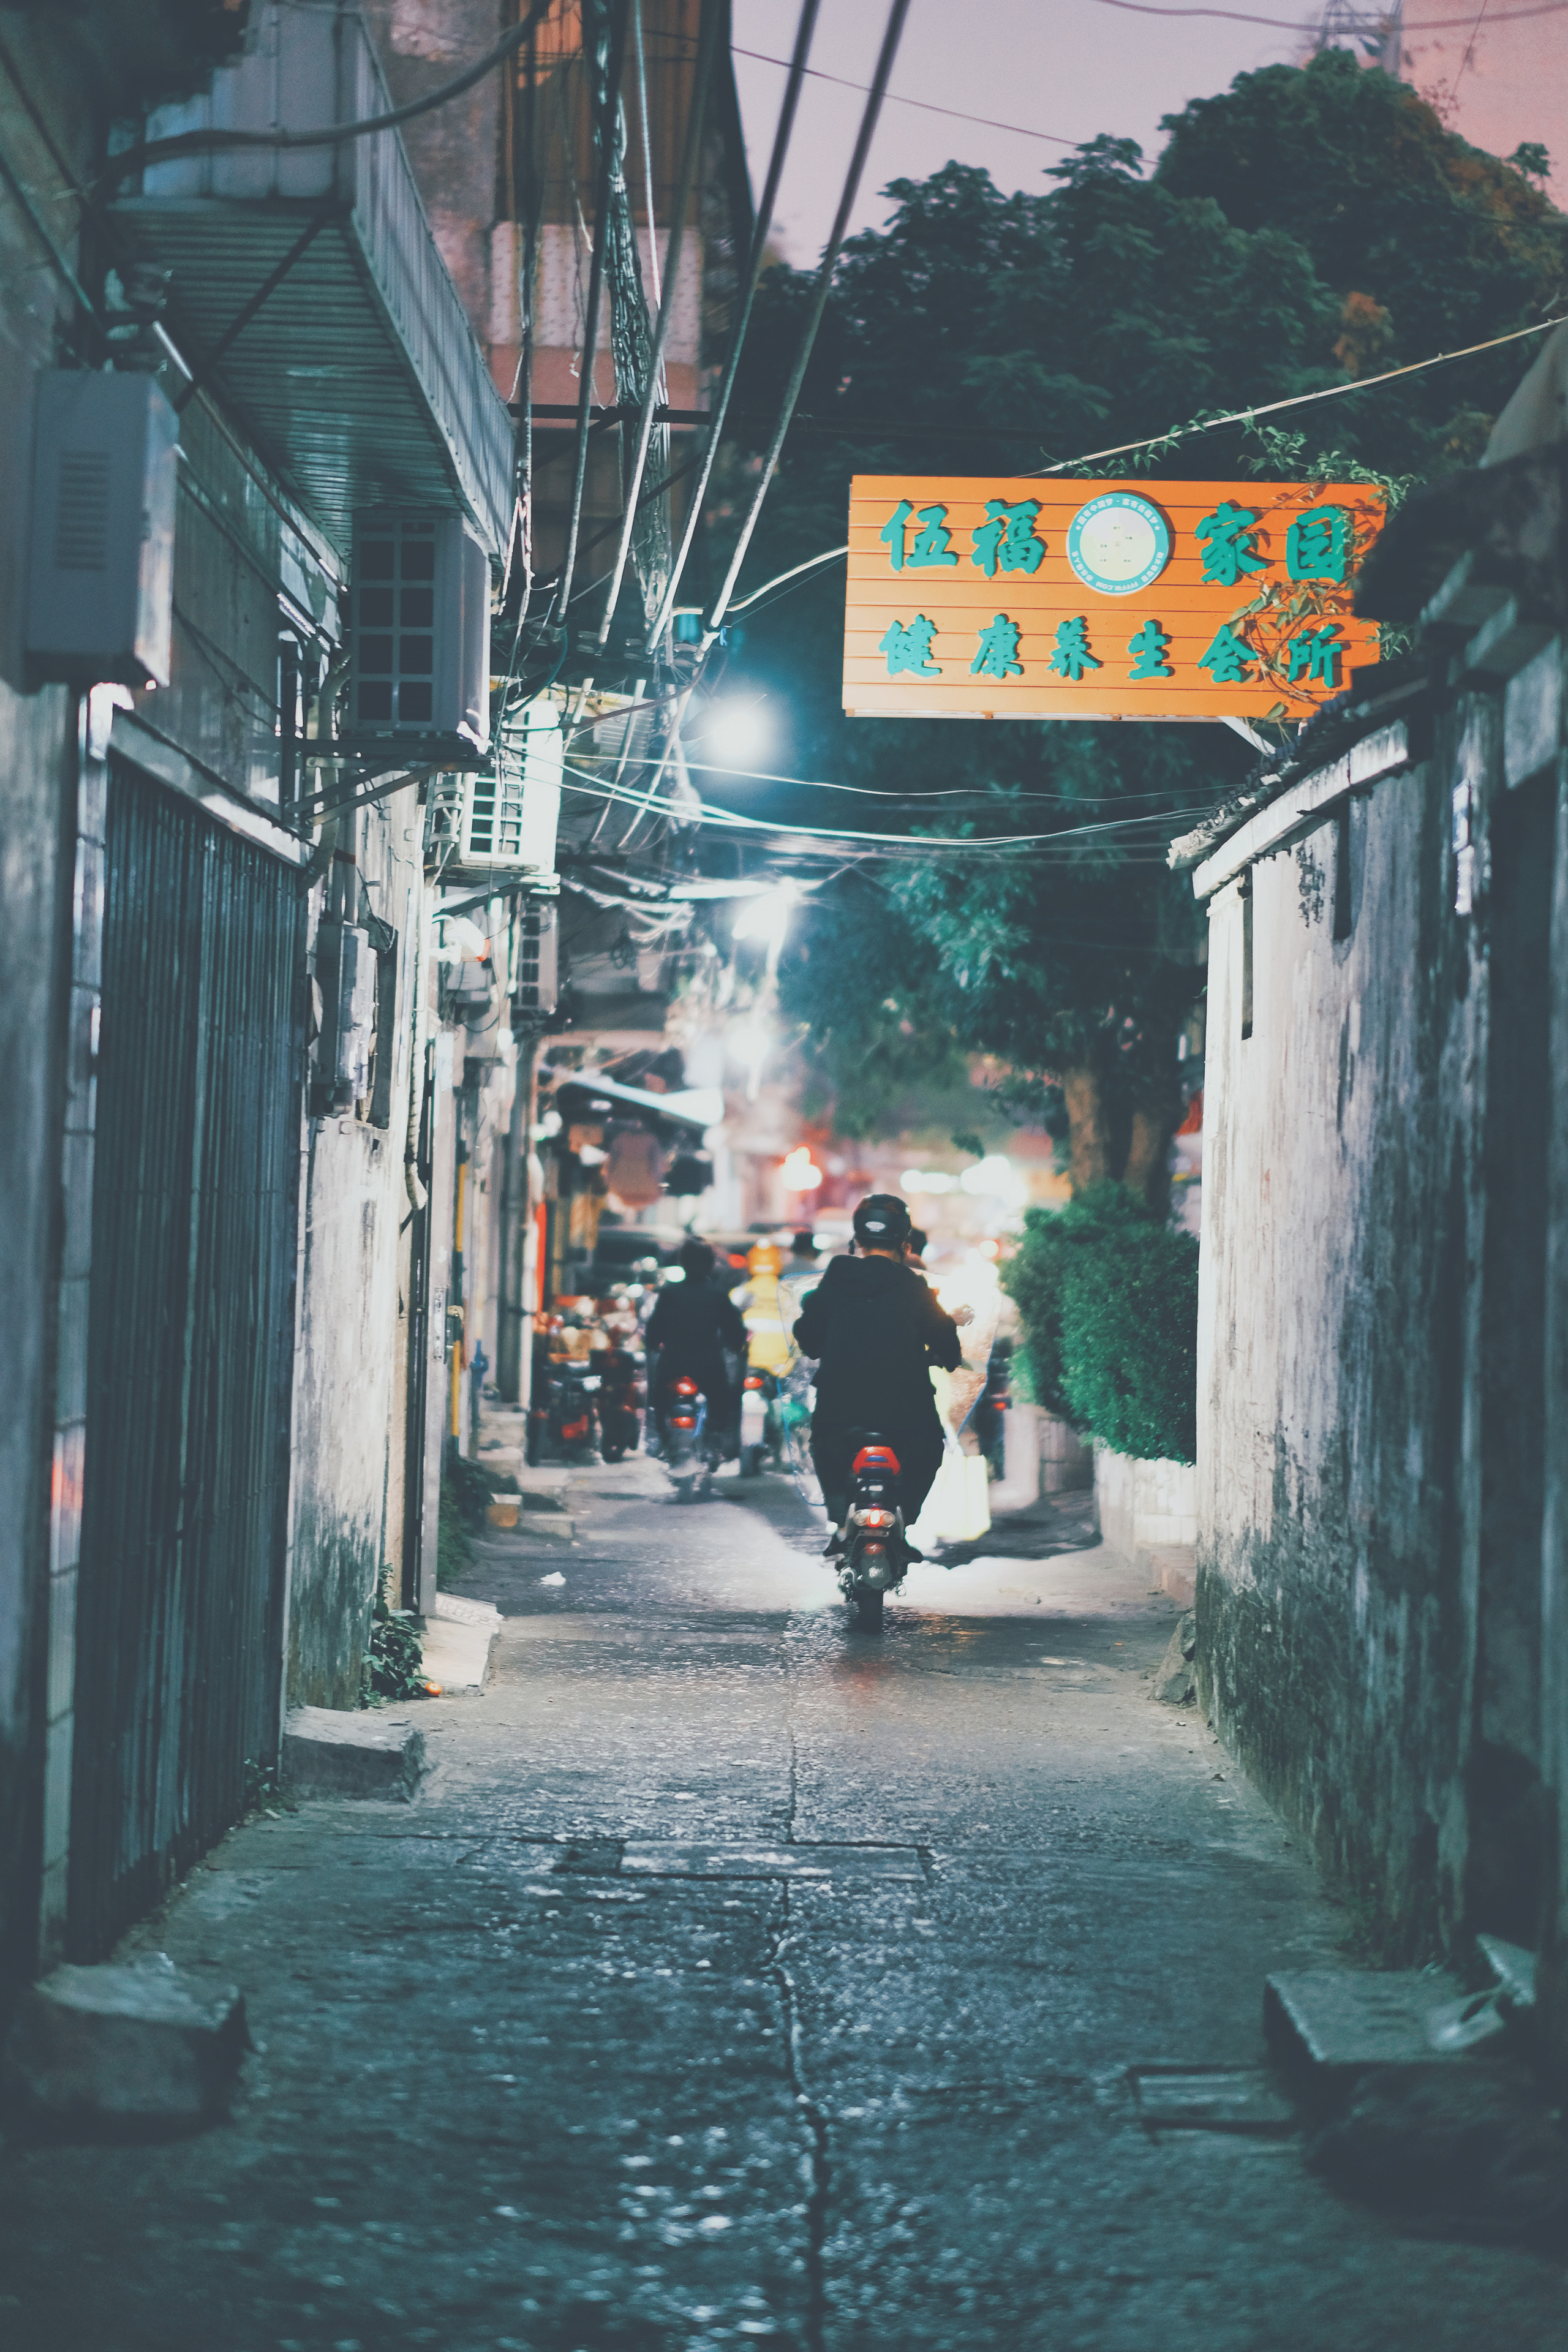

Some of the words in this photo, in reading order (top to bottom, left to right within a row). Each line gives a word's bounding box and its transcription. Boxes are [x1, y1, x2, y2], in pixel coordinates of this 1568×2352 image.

[880, 499, 1046, 579] 伍福
[880, 614, 1342, 688] 健康养生会所
